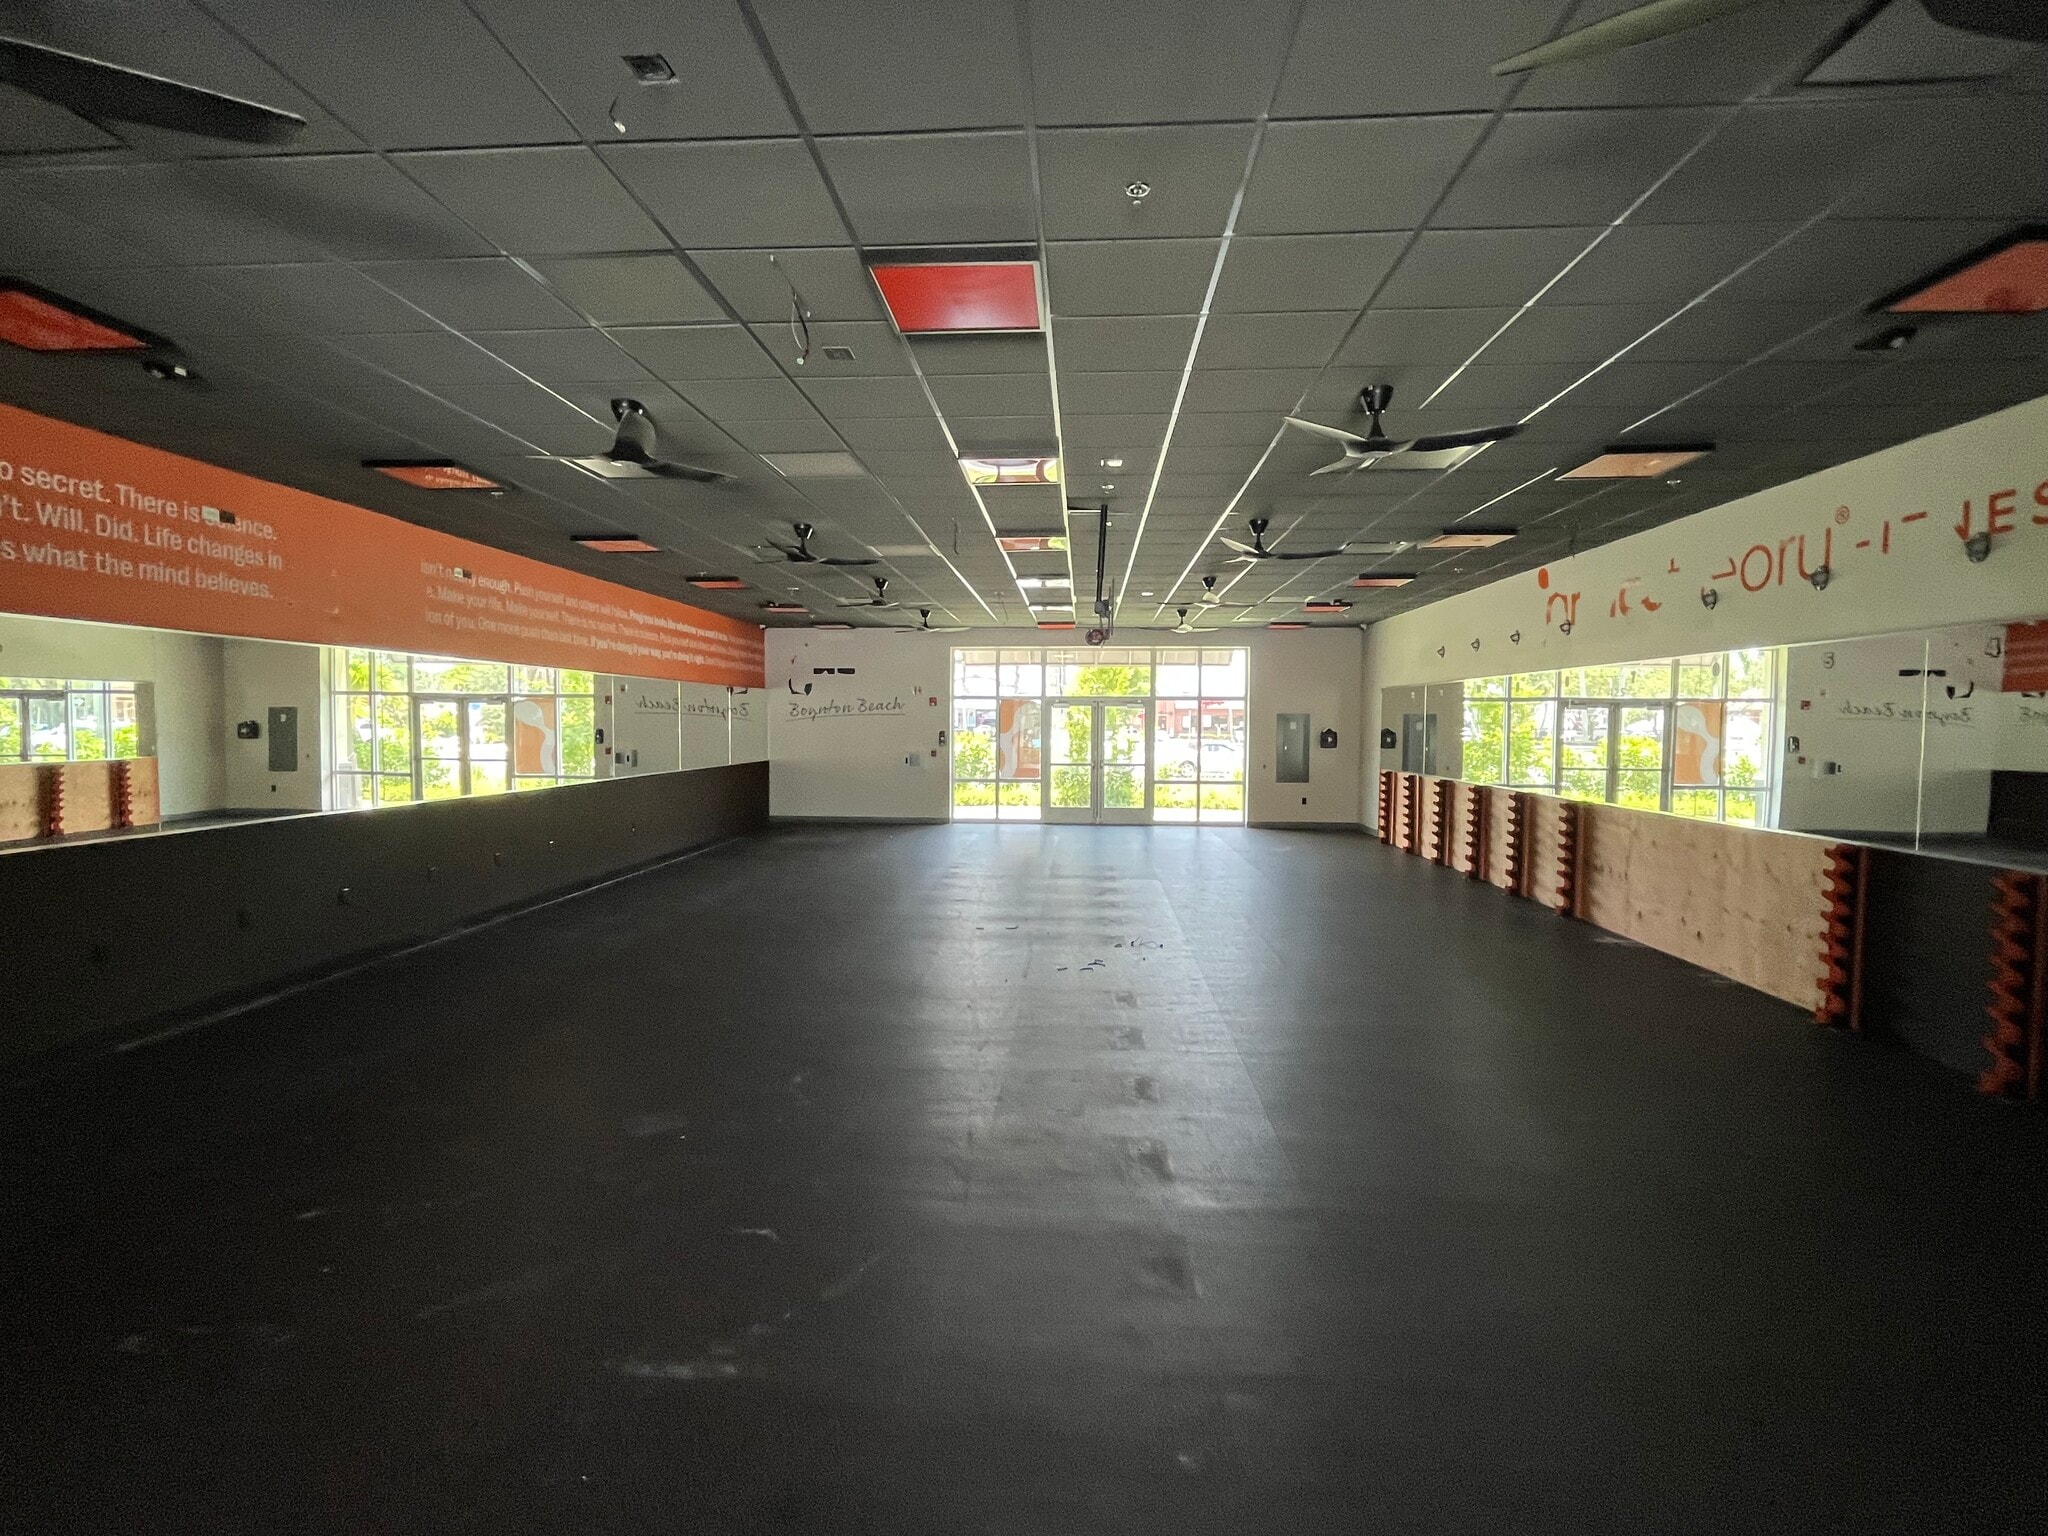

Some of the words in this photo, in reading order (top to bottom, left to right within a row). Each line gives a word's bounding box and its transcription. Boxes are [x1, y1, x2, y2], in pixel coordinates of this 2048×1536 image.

[20, 466, 111, 503] secret.
[115, 483, 178, 518] There
[184, 501, 199, 523] is
[36, 501, 88, 533] Will.
[96, 513, 139, 543] Did.
[144, 523, 182, 551] Life
[187, 535, 265, 567] changes
[268, 550, 282, 570] in
[22, 543, 88, 571] what
[96, 551, 133, 577] the
[139, 562, 190, 586] mind
[195, 568, 273, 599] believes.
[856, 696, 905, 713] Beach
